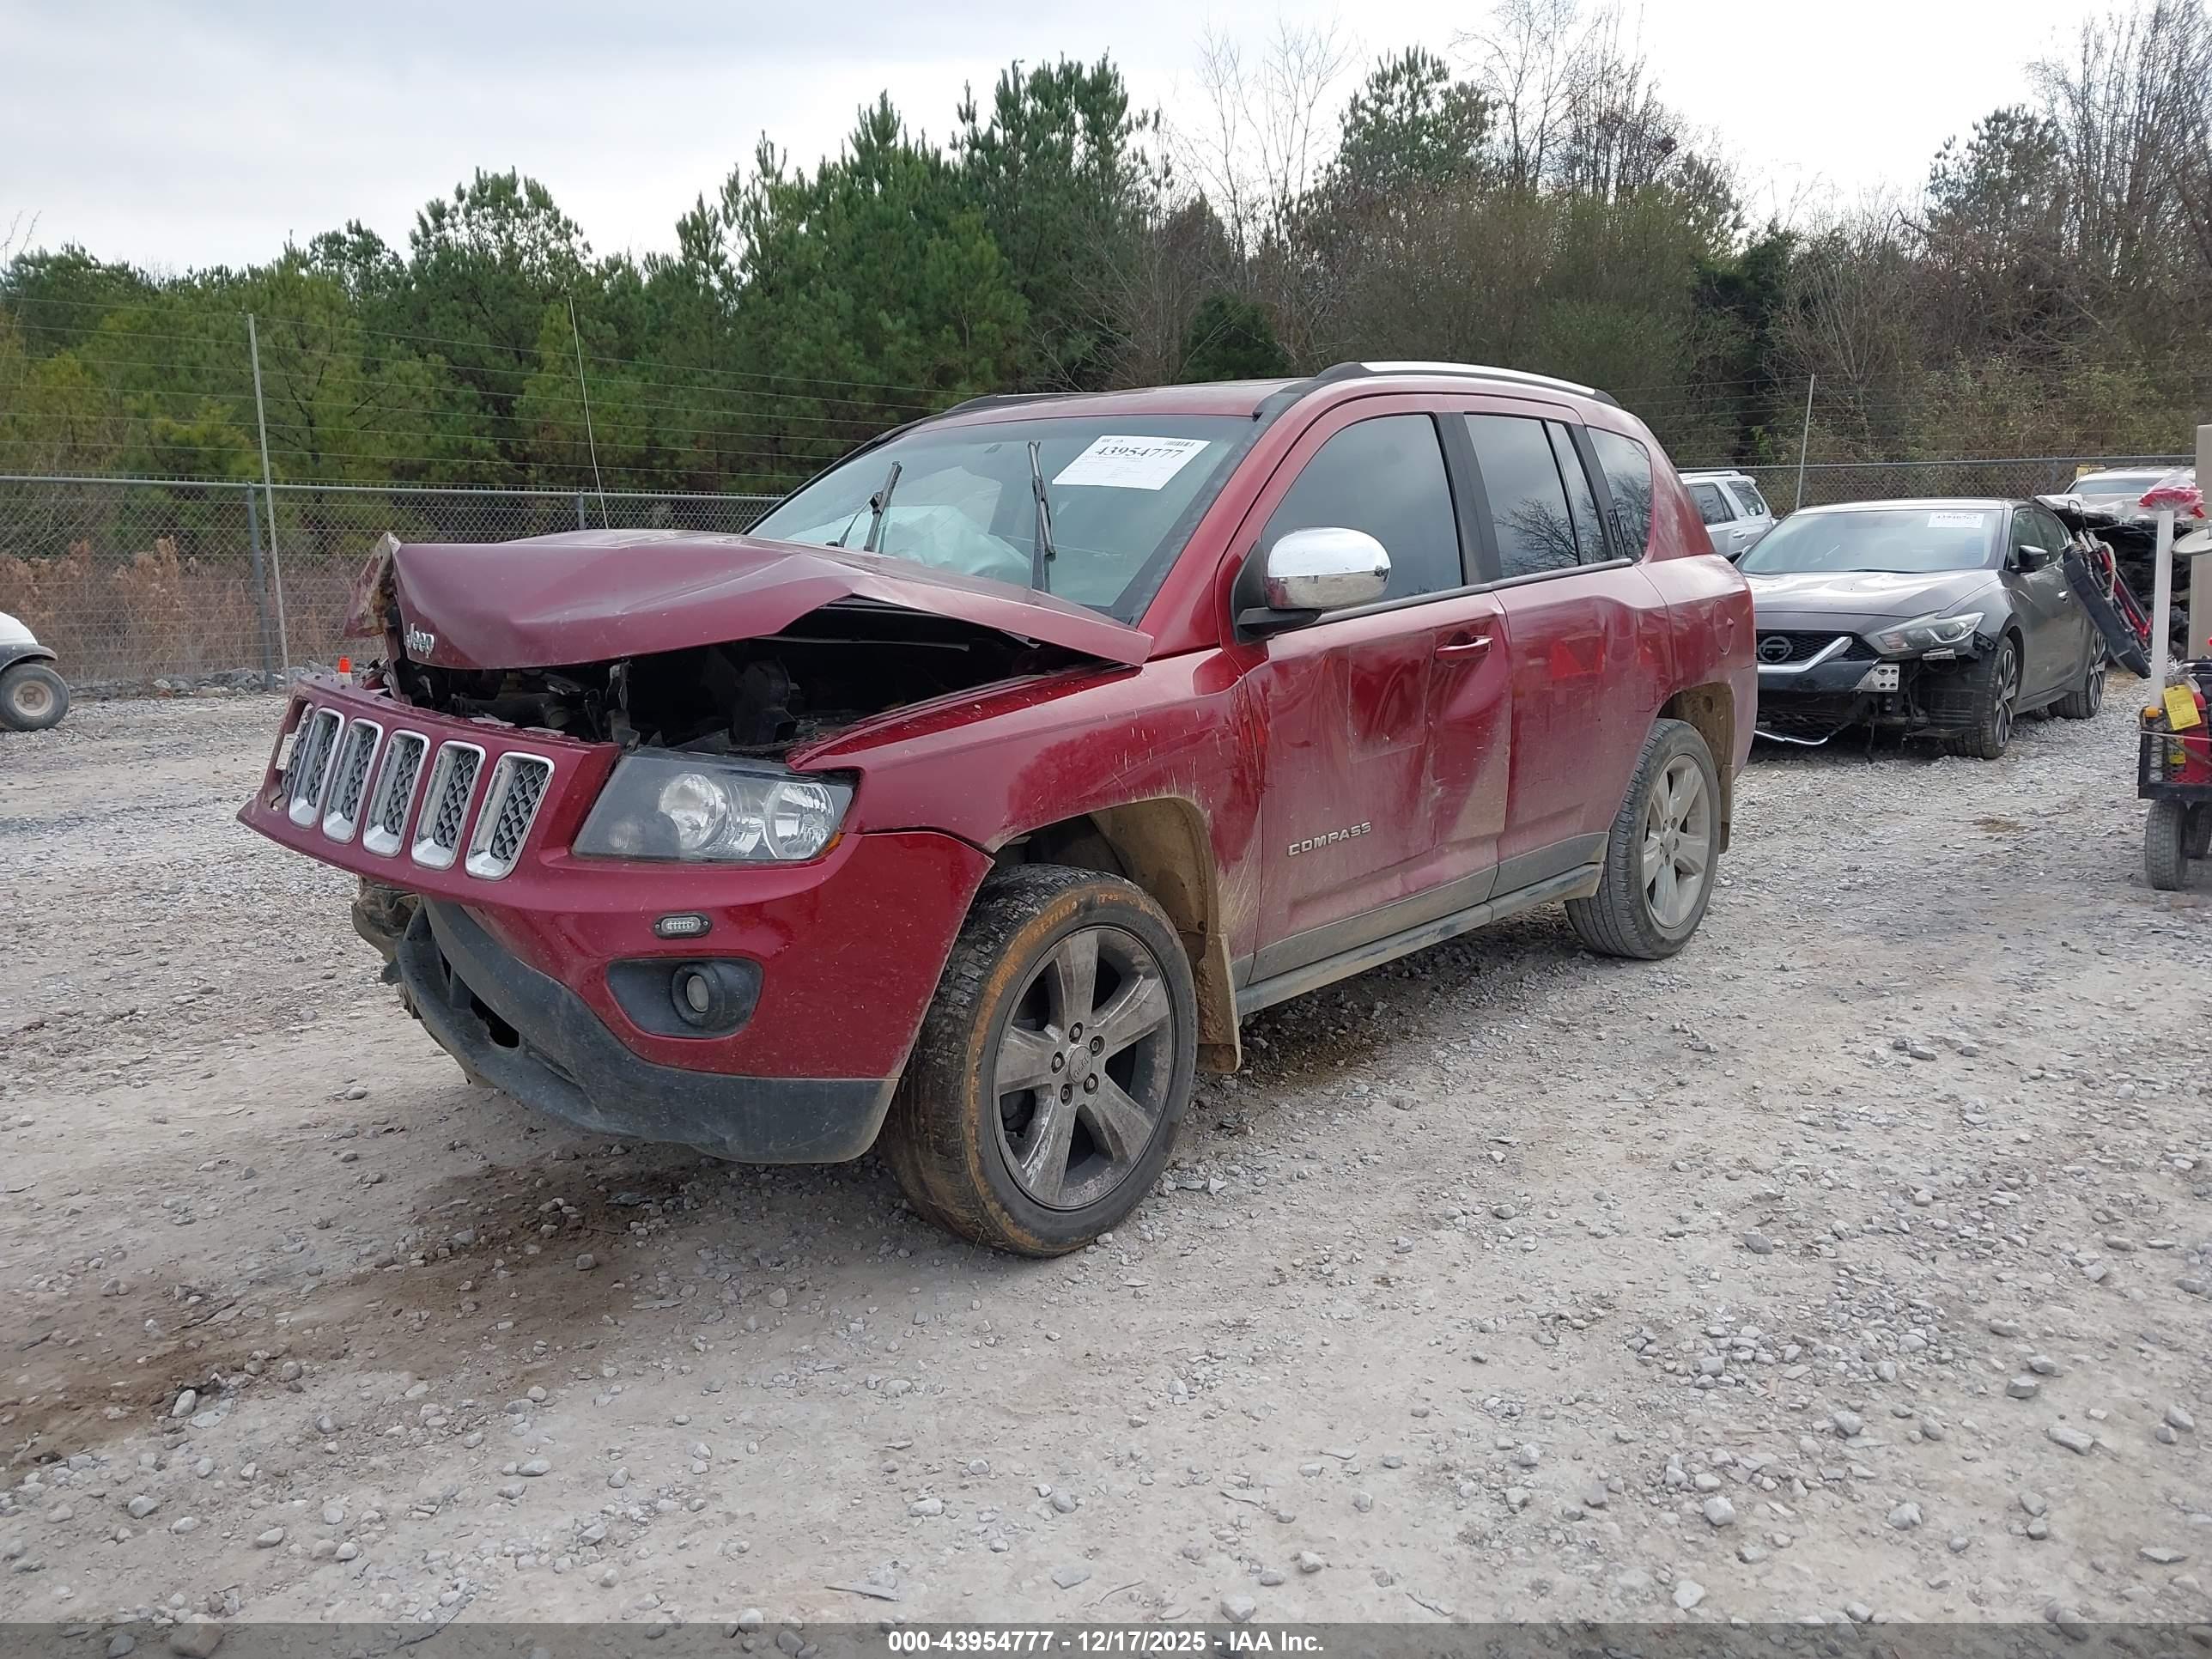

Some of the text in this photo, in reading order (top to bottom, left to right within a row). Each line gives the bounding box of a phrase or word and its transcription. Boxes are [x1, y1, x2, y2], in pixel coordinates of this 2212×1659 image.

[1095, 446, 1185, 460] 43954777
[405, 623, 435, 659] Jeep
[1287, 821, 1372, 857] COMPASS
